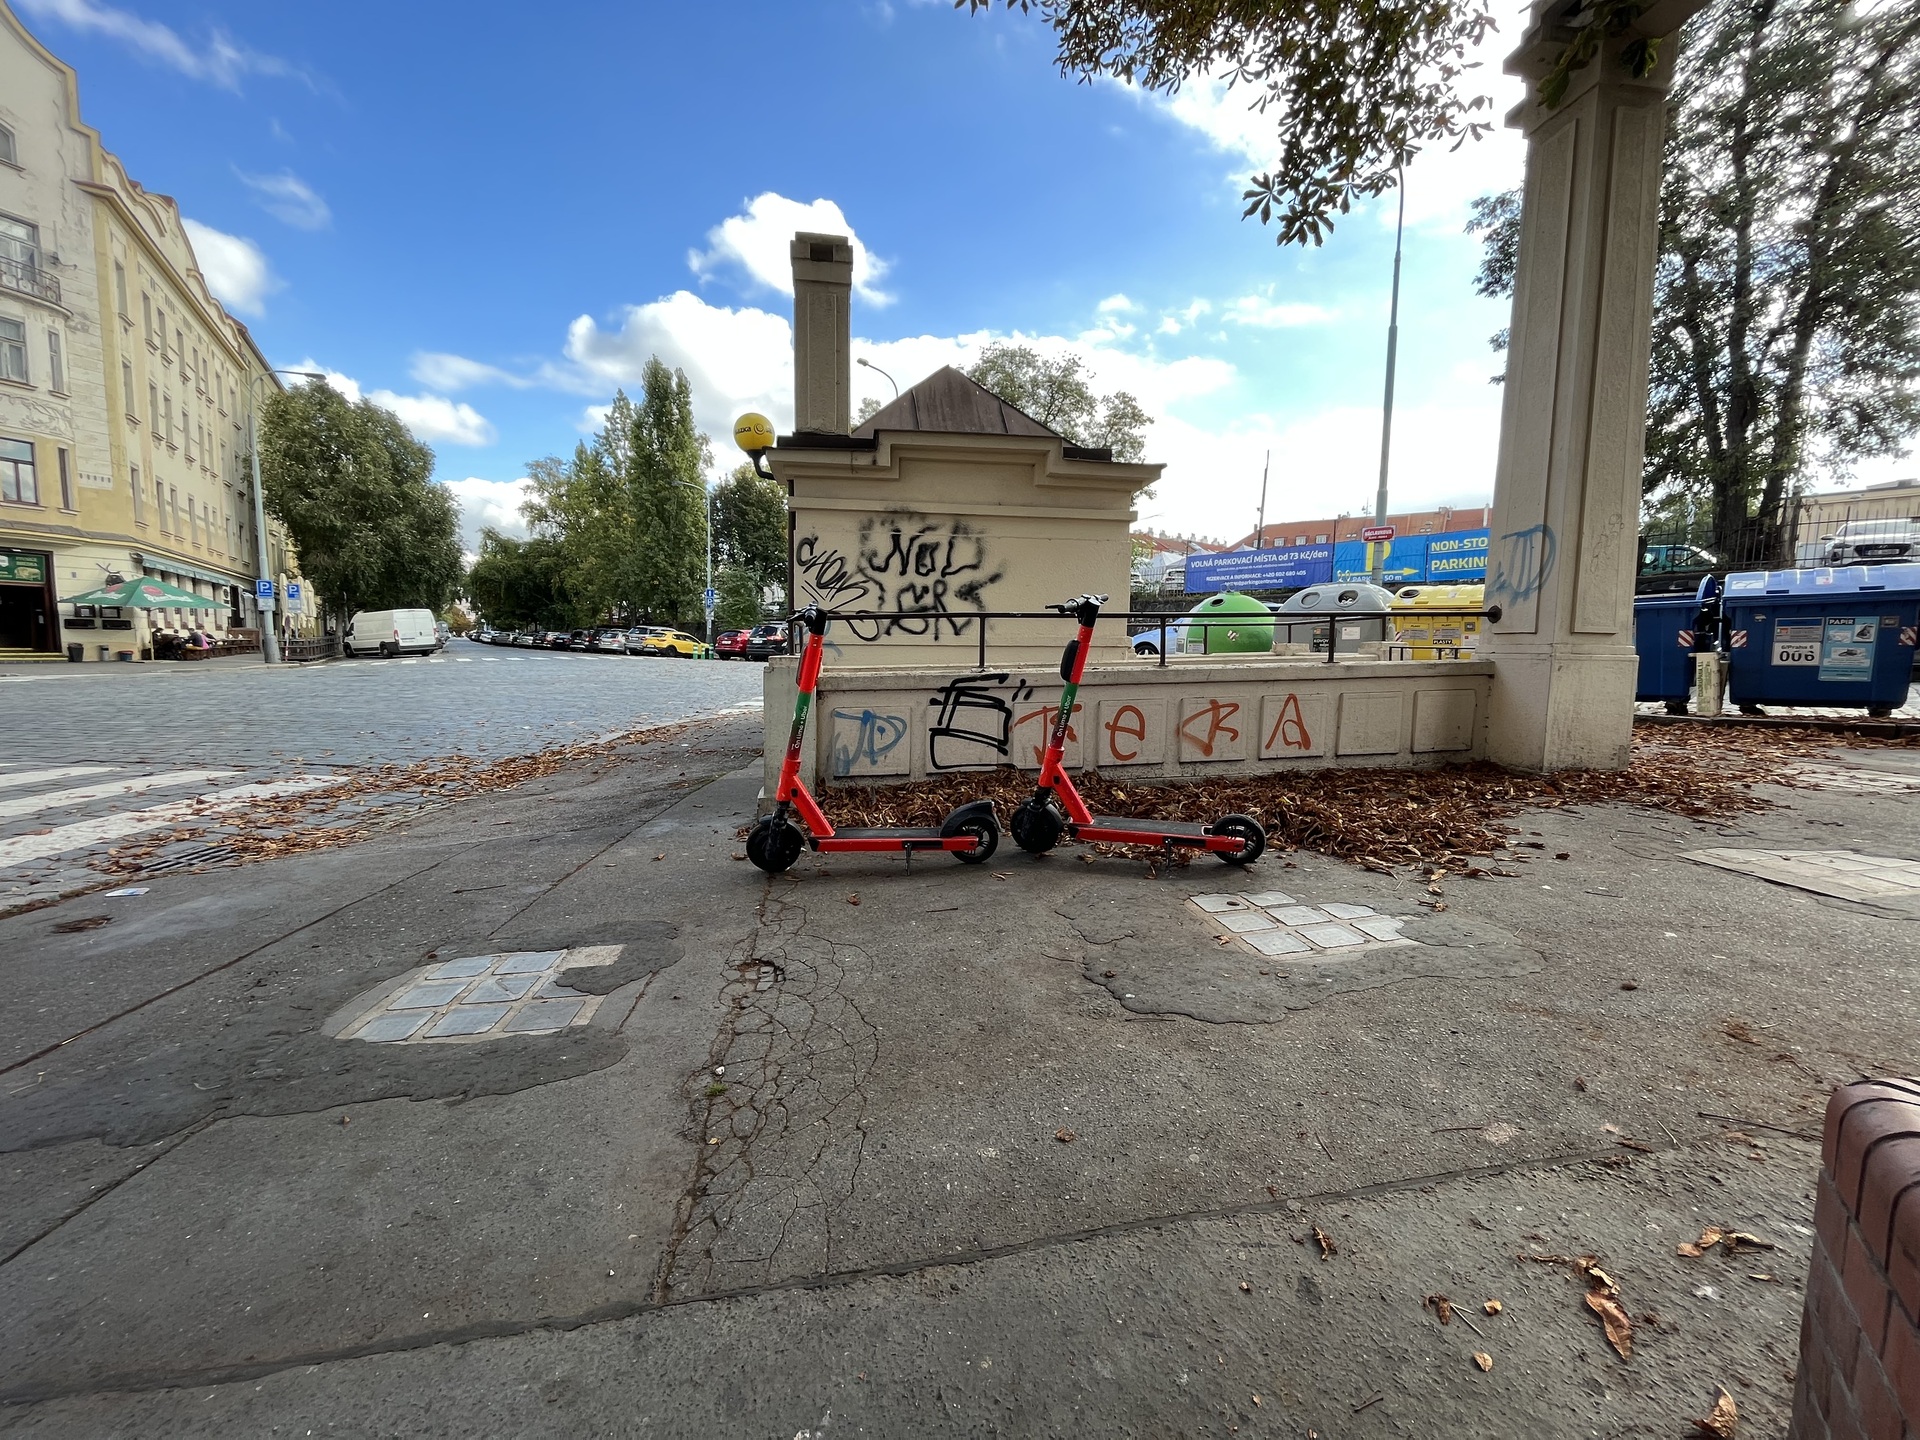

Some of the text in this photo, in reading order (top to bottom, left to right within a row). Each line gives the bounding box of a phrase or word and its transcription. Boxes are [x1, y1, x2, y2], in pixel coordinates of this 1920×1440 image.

[1431, 537, 1487, 551] NON-STO
[1191, 558, 1213, 568] VOLNÁ
[1214, 554, 1253, 566] PARKOVACÍ
[1253, 553, 1278, 563] MÍSTA
[1278, 552, 1288, 561] od
[1289, 552, 1299, 560] 73
[1300, 550, 1328, 560] Kč/den
[1779, 650, 1815, 662] 006
[800, 705, 808, 720] Uber
[1056, 728, 1064, 737] On
[1064, 695, 1072, 709] Uber
